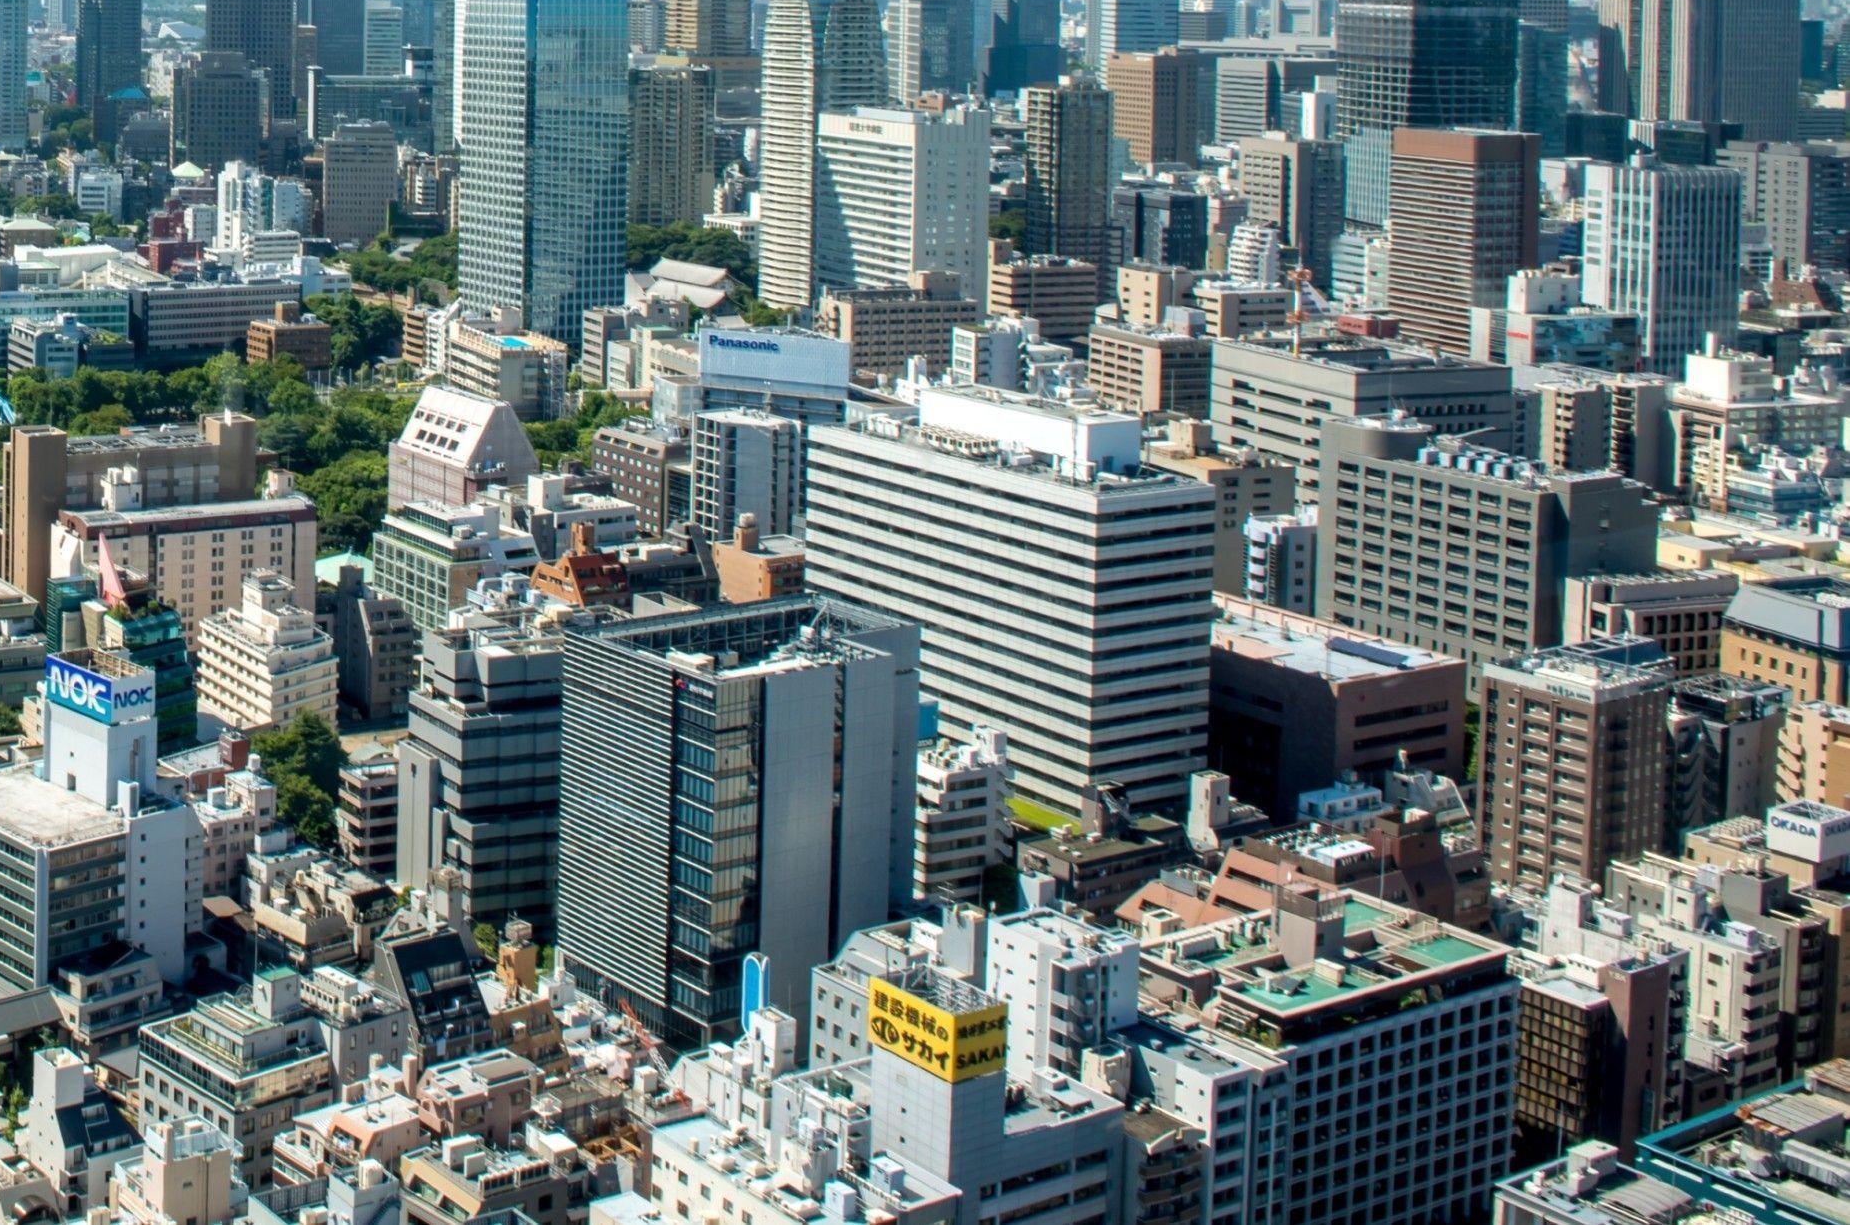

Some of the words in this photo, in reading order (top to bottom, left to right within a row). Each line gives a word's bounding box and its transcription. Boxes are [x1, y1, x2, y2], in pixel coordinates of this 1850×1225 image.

[708, 334, 781, 352] Panasonic
[50, 664, 107, 716] NOK
[113, 685, 153, 710] NOK
[1770, 815, 1818, 839] OKADA
[874, 988, 949, 1042] 建設機械の
[901, 1029, 950, 1072] サカイ
[955, 1043, 1007, 1070] SAKAI
